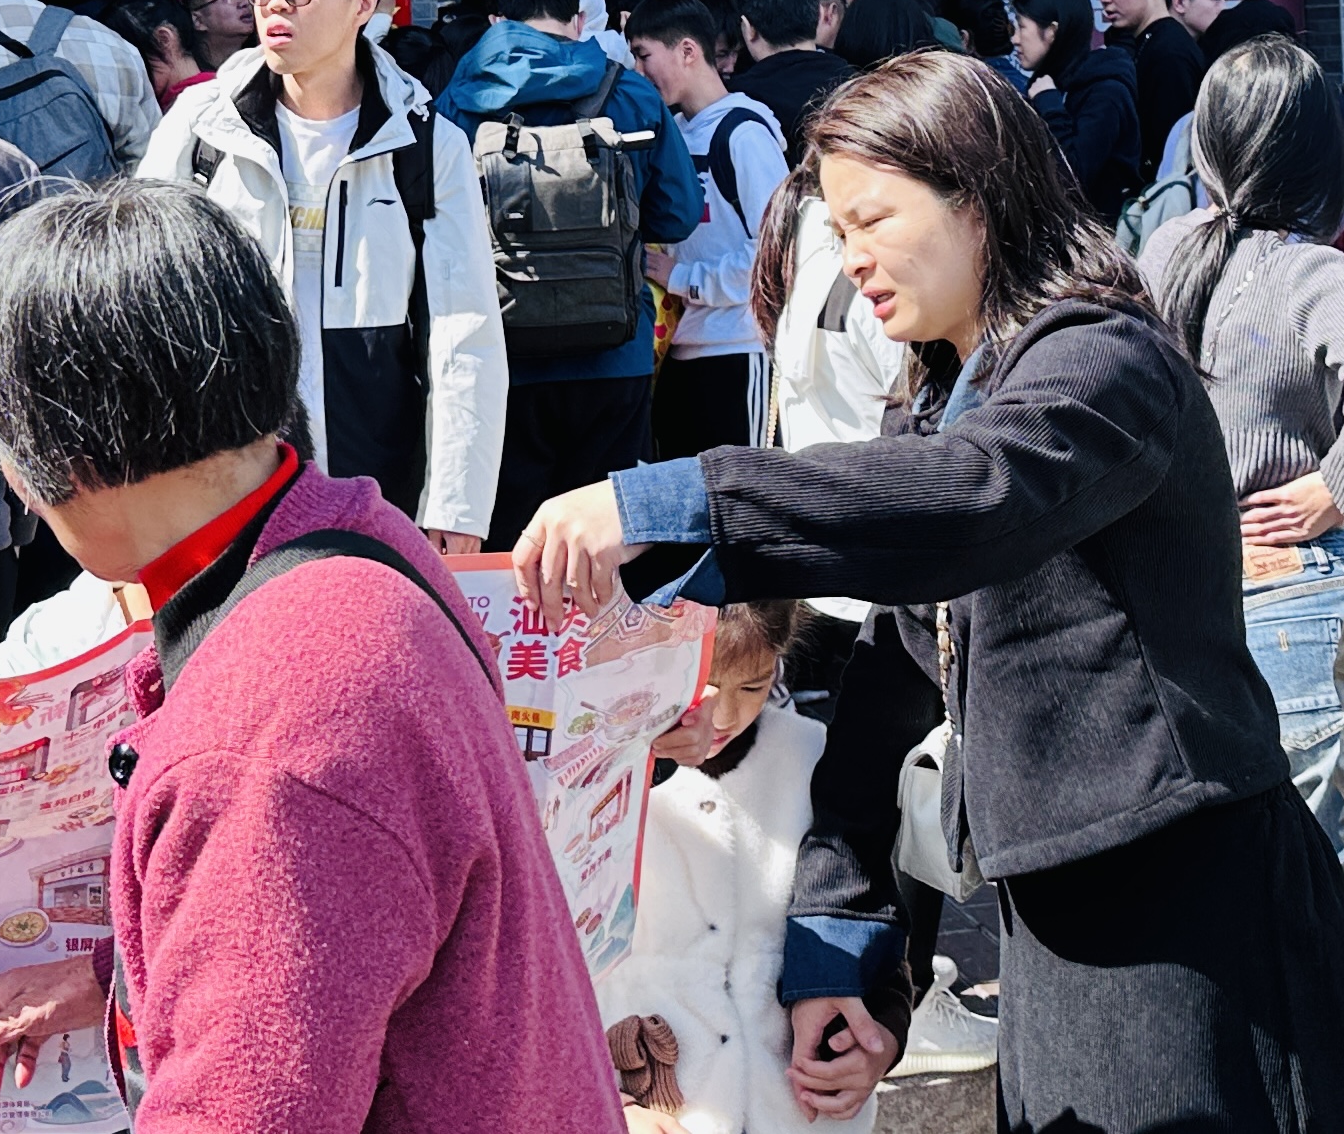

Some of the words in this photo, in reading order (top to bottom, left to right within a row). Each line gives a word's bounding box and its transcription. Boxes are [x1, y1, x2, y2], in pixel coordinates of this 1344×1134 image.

[505, 639, 588, 682] 美食
[506, 709, 541, 725] 肉火锅
[65, 937, 101, 953] 银屏
